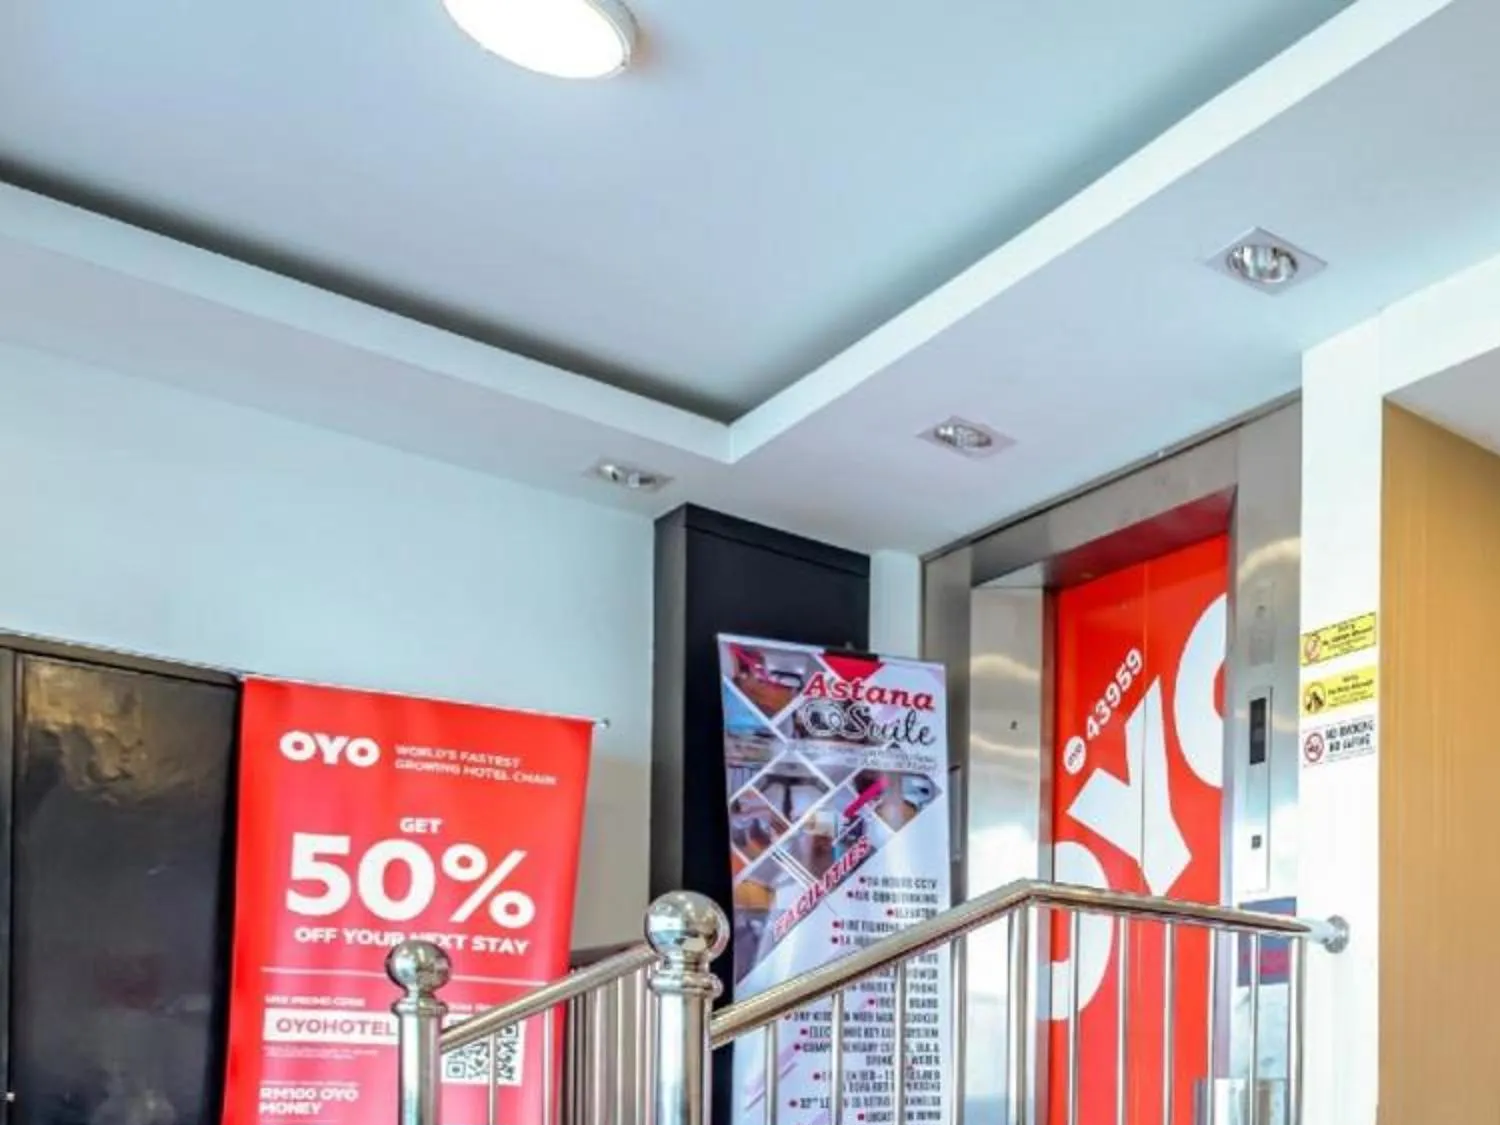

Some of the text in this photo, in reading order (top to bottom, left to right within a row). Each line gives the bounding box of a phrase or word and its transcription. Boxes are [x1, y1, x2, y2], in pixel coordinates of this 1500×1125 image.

[803, 671, 935, 713] Astana
[1086, 647, 1142, 741] 43959
[280, 730, 380, 768] OYO
[395, 744, 520, 769] WORLD'S FASTEST
[400, 816, 442, 834] GET
[285, 832, 536, 929] 50%
[294, 927, 338, 944] OFF
[472, 936, 531, 956] STAY
[259, 1101, 322, 1115] MONEY
[260, 1087, 359, 1102] RM100 OYO
